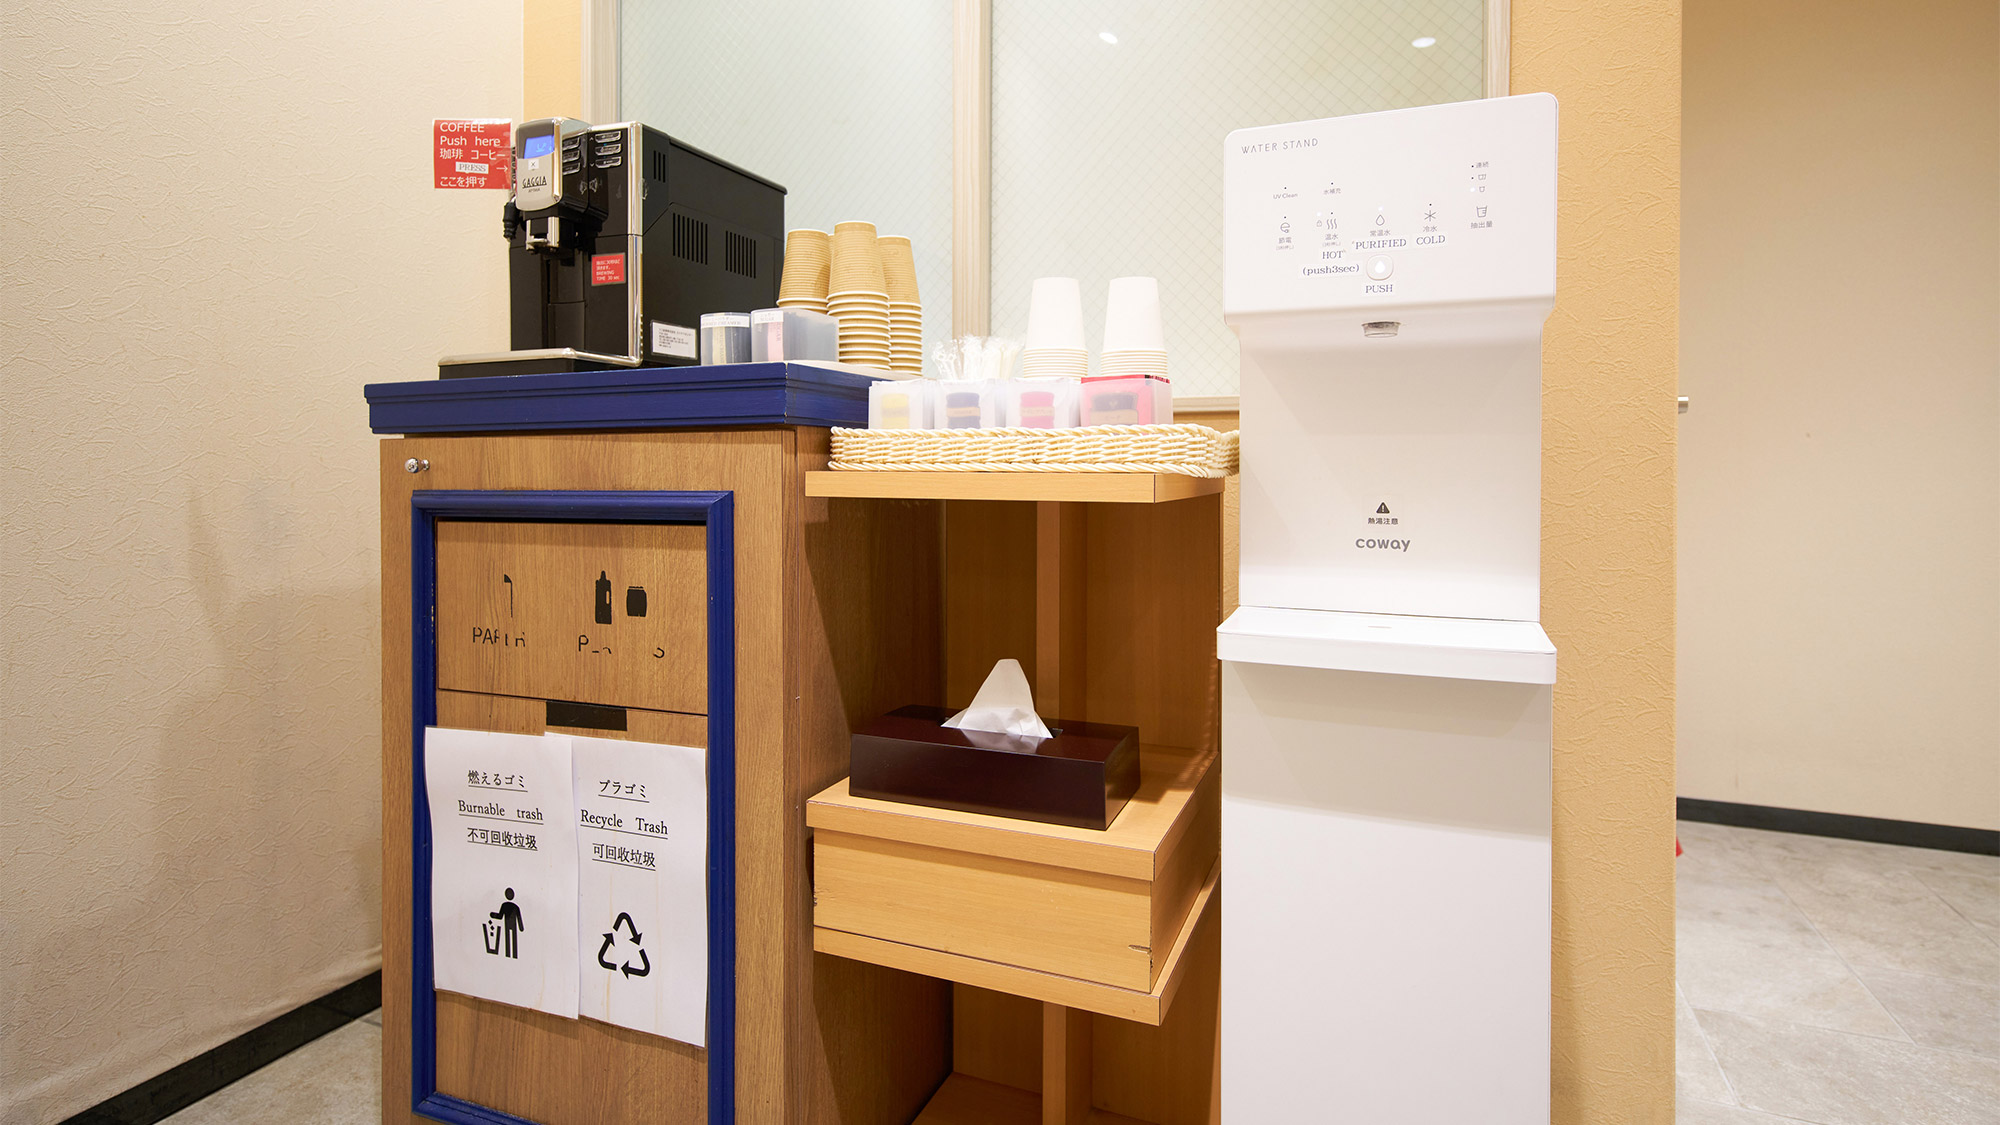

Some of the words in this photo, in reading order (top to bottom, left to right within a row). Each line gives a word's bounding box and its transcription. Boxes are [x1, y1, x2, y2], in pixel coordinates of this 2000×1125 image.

[440, 122, 485, 133] COFFEE
[440, 135, 467, 146] Push
[475, 135, 501, 147] here
[1241, 142, 1278, 154] WATER
[1283, 138, 1319, 150] STAND
[440, 148, 463, 160] 珈琲
[471, 149, 506, 160] コーヒー
[459, 163, 487, 172] PRESS
[440, 176, 487, 188] ここを押す
[522, 176, 547, 188] GAGGIA
[1355, 238, 1407, 250] PURIFIED
[1416, 234, 1446, 245] COLD
[1322, 250, 1343, 259] HOT
[1302, 264, 1360, 276] (push3sec)
[1365, 284, 1393, 294] PUSH
[1355, 538, 1411, 553] coway
[467, 769, 526, 788] 燃えるゴミ
[599, 779, 647, 799] プラゴミ
[458, 800, 505, 818] Burnable
[517, 807, 543, 822] trash
[580, 809, 623, 829] Recycle
[635, 817, 669, 835] Trash
[467, 827, 538, 850] 不可回收垃圾
[592, 843, 656, 869] 可回收垃圾
